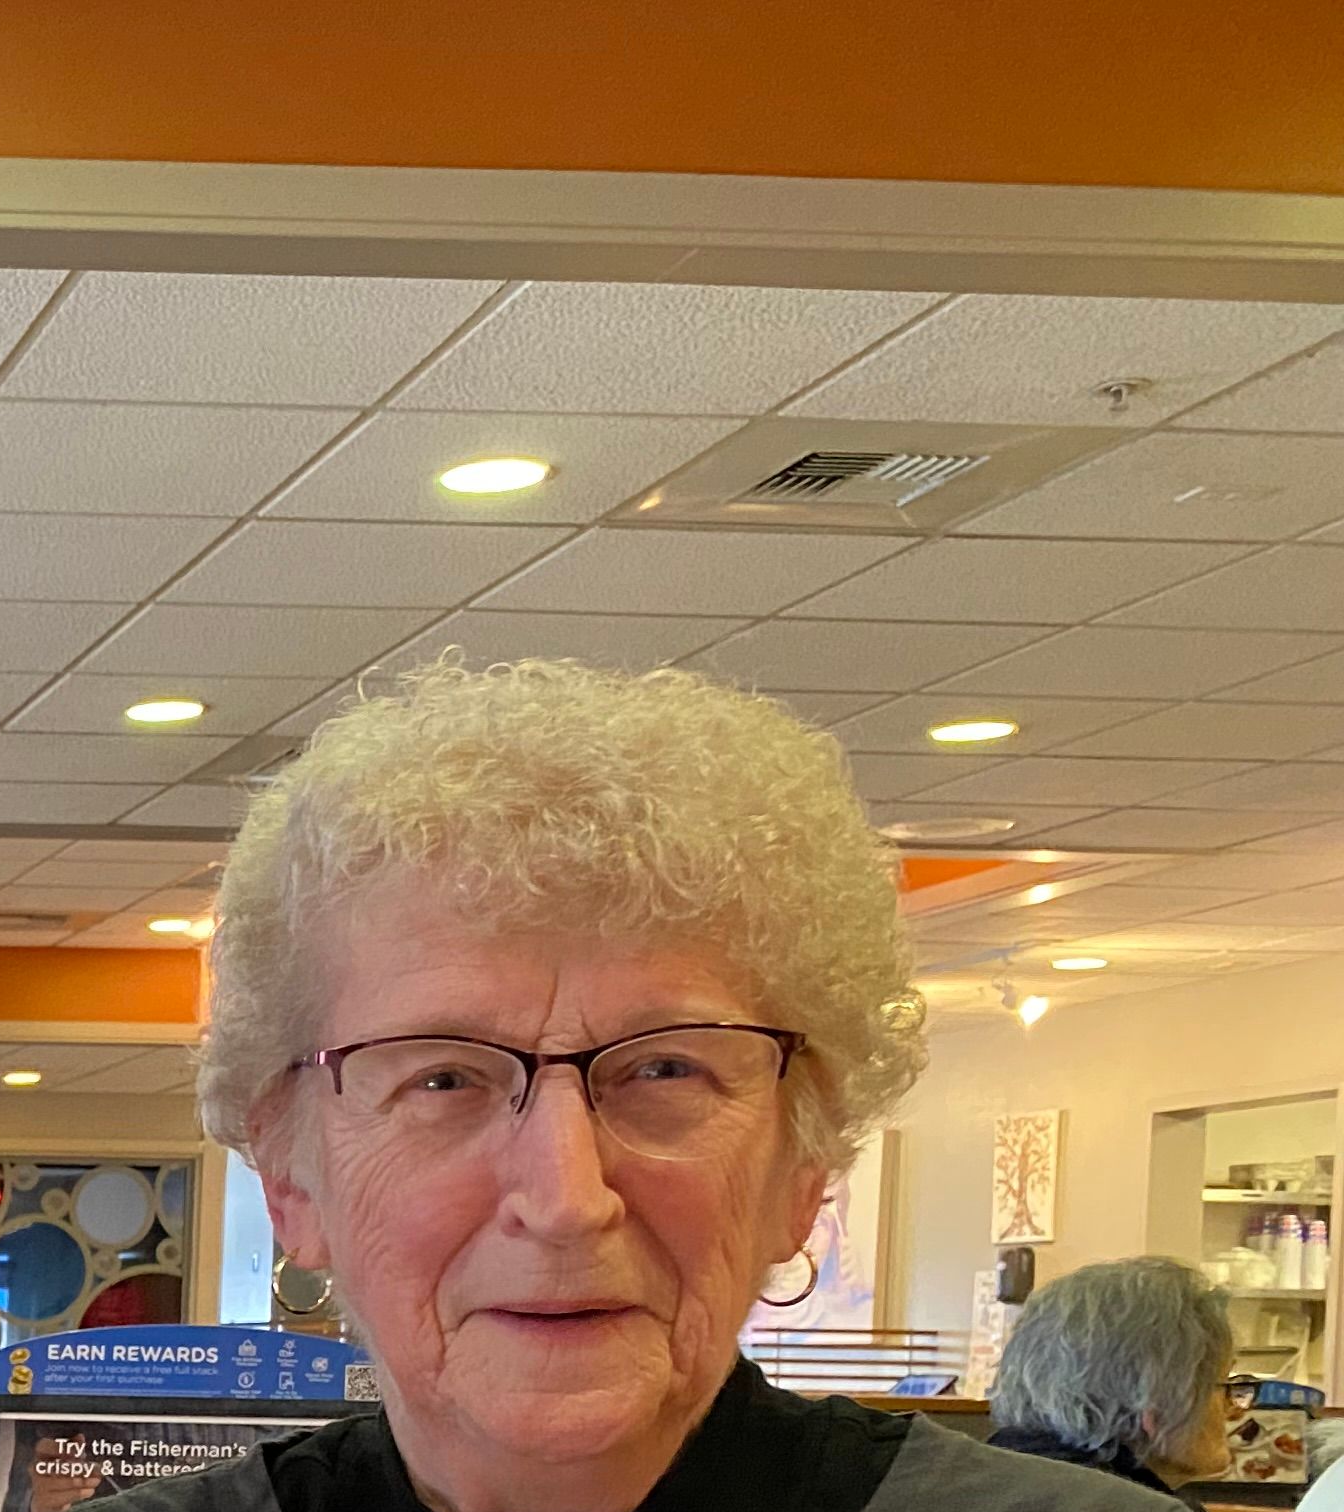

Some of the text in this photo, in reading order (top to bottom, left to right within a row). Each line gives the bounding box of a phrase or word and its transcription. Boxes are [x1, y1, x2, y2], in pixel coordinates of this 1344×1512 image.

[47, 1344, 105, 1361] EARN
[113, 1345, 219, 1363] REWARDS
[45, 1373, 68, 1382] after
[70, 1375, 93, 1383] your
[92, 1365, 103, 1373] to
[55, 1438, 86, 1456] Try
[92, 1440, 124, 1456] the
[35, 1459, 95, 1477] crispy
[101, 1461, 114, 1476] &
